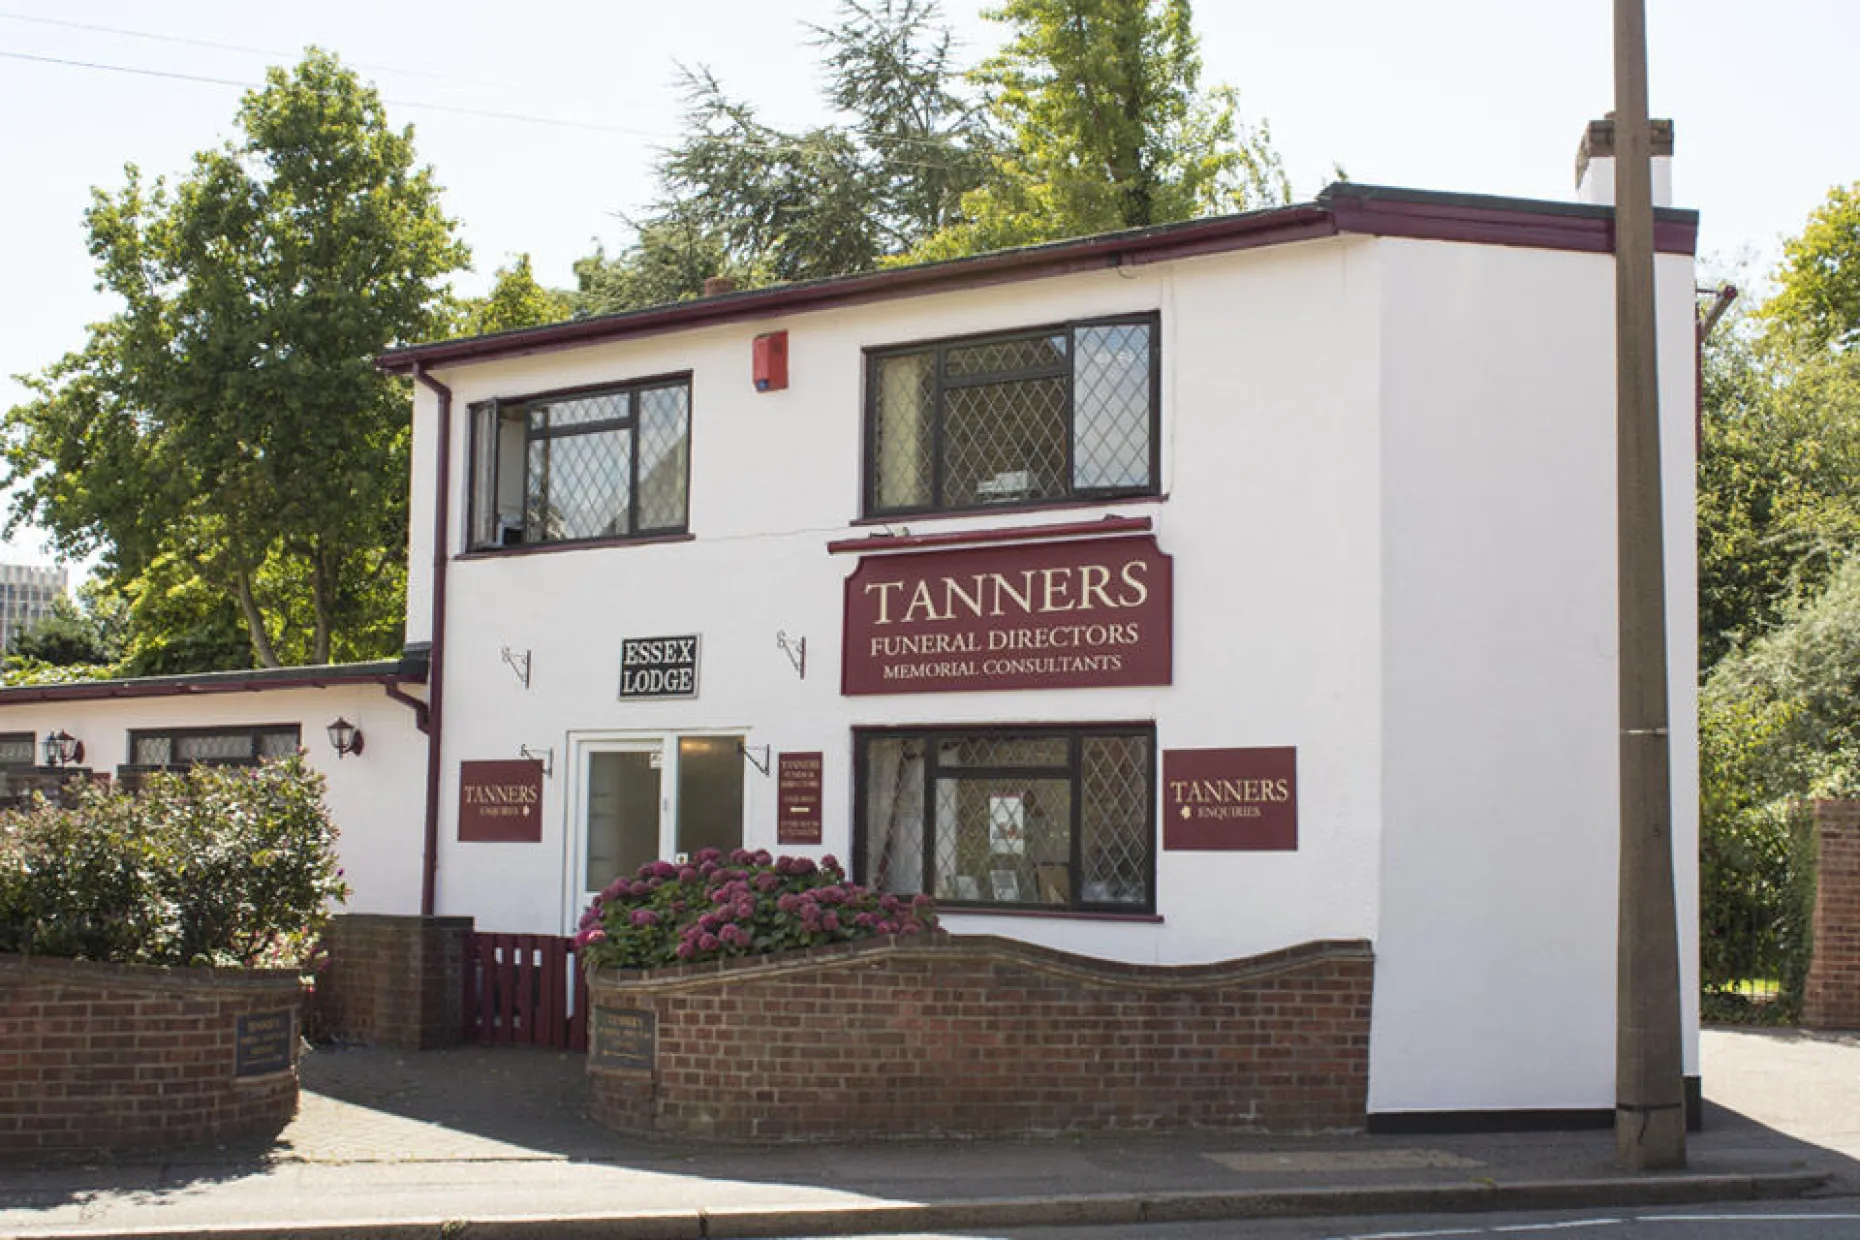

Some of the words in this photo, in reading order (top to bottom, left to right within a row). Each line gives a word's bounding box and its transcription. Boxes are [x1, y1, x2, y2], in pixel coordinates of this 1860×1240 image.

[864, 560, 1148, 625] TANNERS
[624, 639, 694, 665] ESSEX
[870, 632, 980, 658] FUNERAL
[988, 623, 1139, 651] DIRECTORS
[883, 660, 978, 680] MEMORIAL
[983, 655, 1122, 676] CONSULTANTS
[623, 668, 692, 694] LODGE
[464, 783, 538, 804] TANNERS
[1169, 779, 1288, 803] TANNERS
